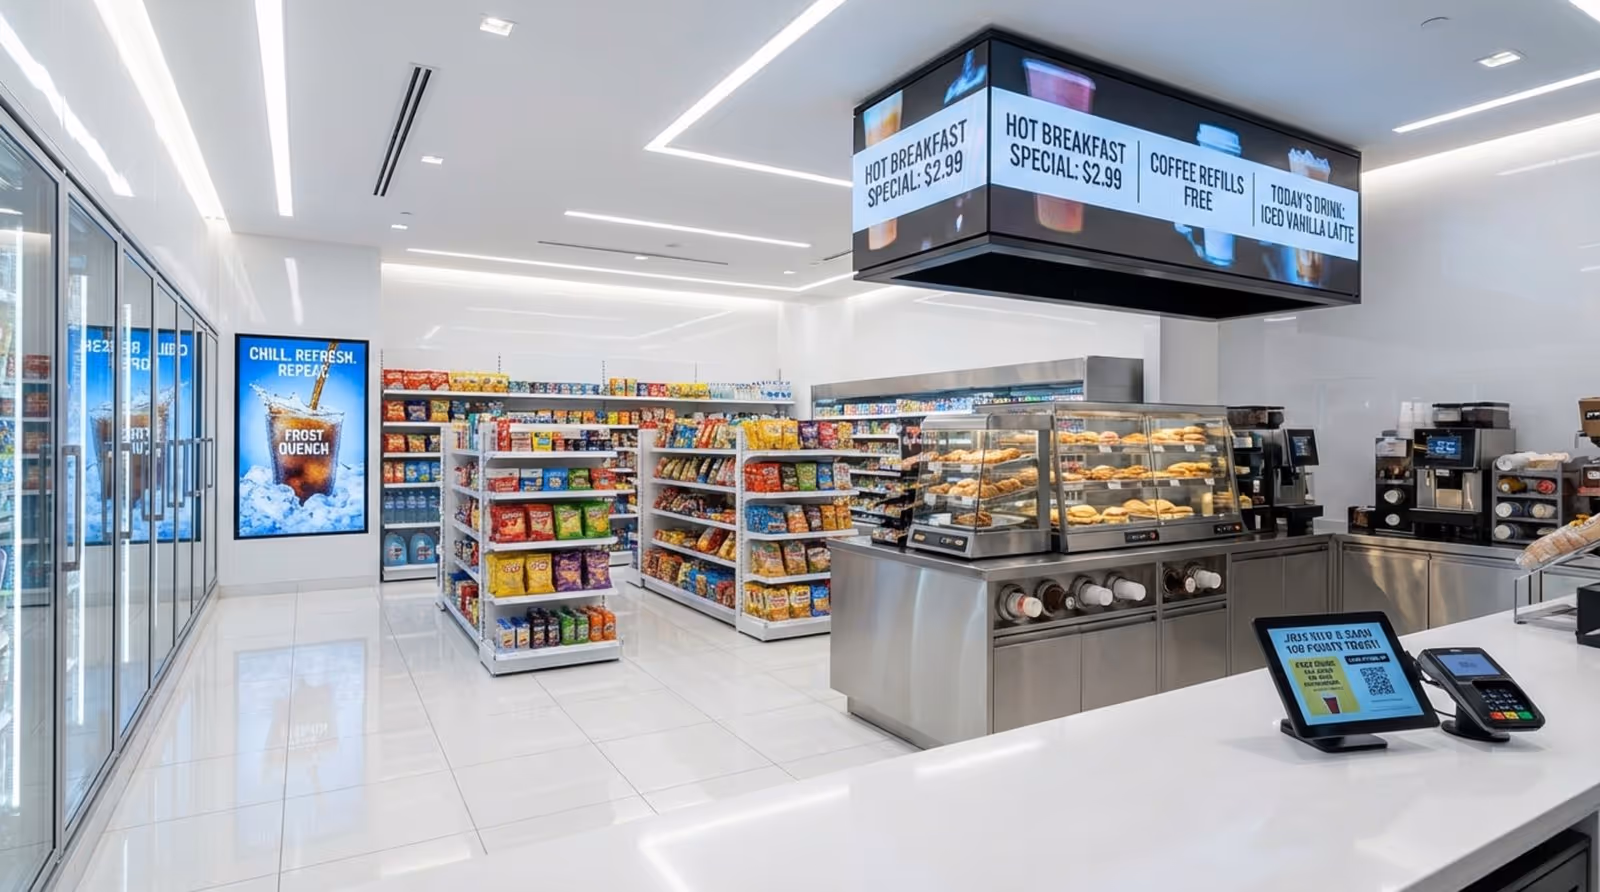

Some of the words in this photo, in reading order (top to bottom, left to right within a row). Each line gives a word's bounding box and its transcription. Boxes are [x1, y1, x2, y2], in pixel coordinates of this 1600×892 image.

[865, 156, 888, 185] HOT
[891, 118, 967, 175] BREAKFAST
[1006, 112, 1038, 142] HOT
[1042, 122, 1126, 164] BREAKFAST
[867, 170, 921, 208] SPECIAL:
[924, 150, 963, 187] $2.99
[1010, 143, 1079, 180] SPECIAL:
[1083, 160, 1122, 190] $2.99
[1150, 152, 1197, 183] COFFEE
[1200, 164, 1245, 195] REFILLS
[1184, 185, 1213, 211] FREE
[1271, 184, 1312, 212] TODAY'S
[1314, 196, 1345, 220] DRINK:
[1261, 204, 1284, 227] ICED
[1286, 210, 1326, 237] VANILLA
[1327, 221, 1355, 244] LATTE
[249, 346, 292, 361] CHILL.
[295, 348, 357, 365] REFRESH.
[285, 429, 324, 441] FROST
